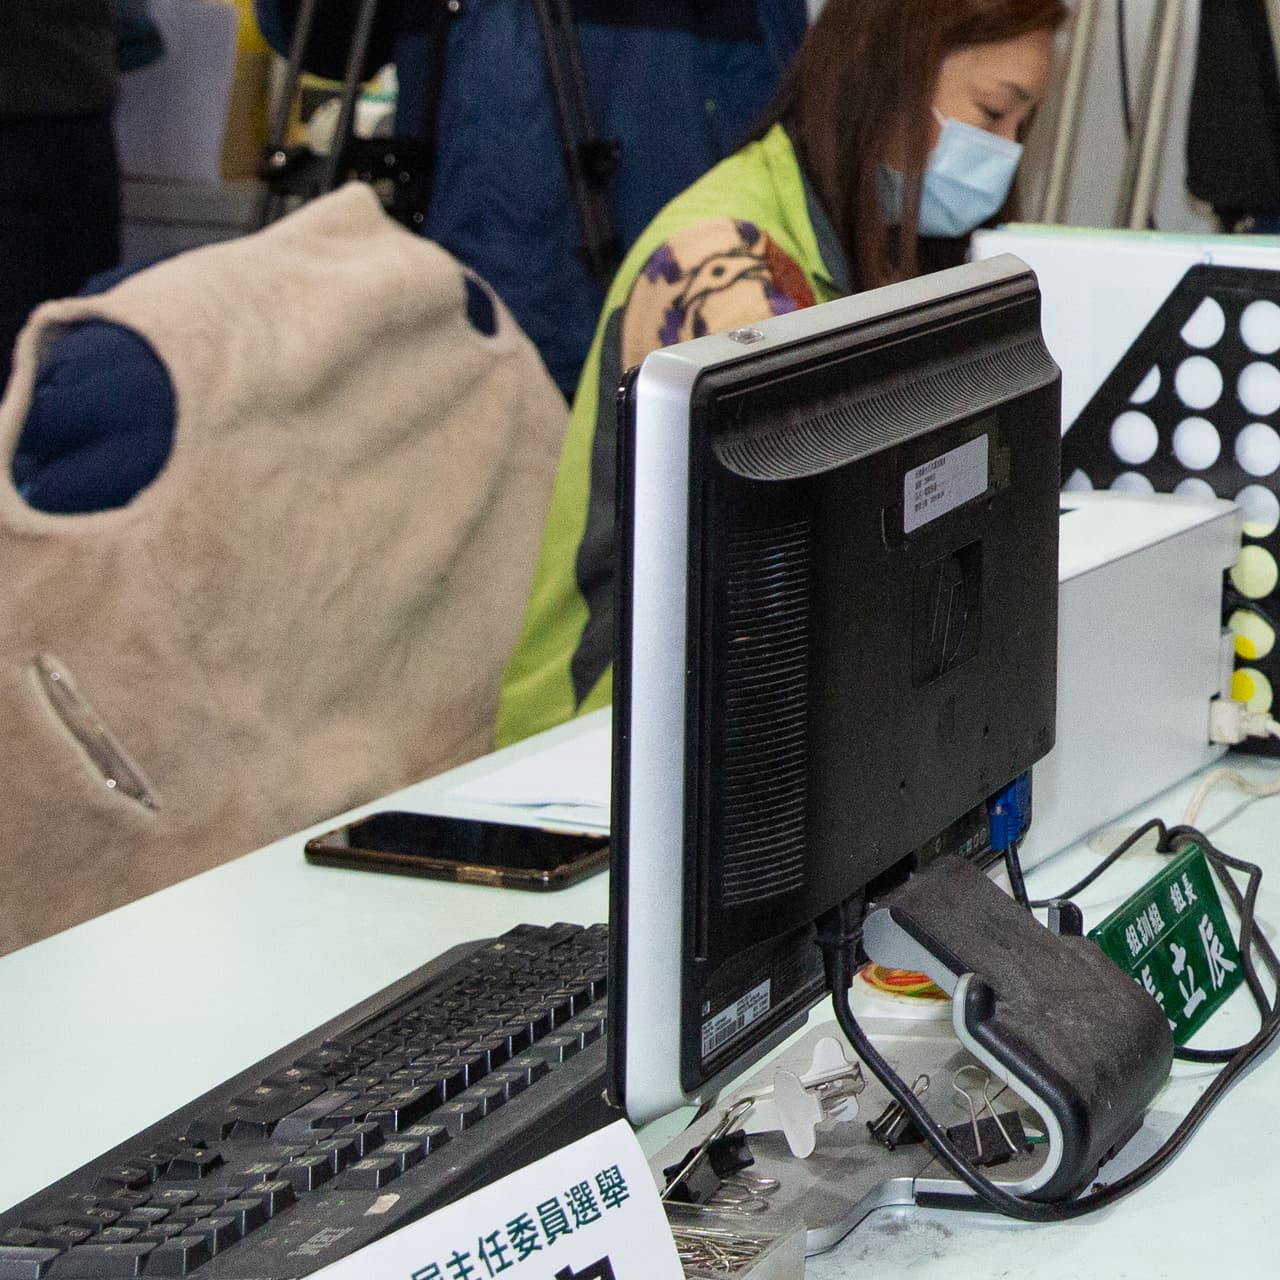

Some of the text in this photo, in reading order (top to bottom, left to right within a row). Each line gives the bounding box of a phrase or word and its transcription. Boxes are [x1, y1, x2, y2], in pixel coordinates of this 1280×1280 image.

[1125, 872, 1198, 958] 組訓組 組長
